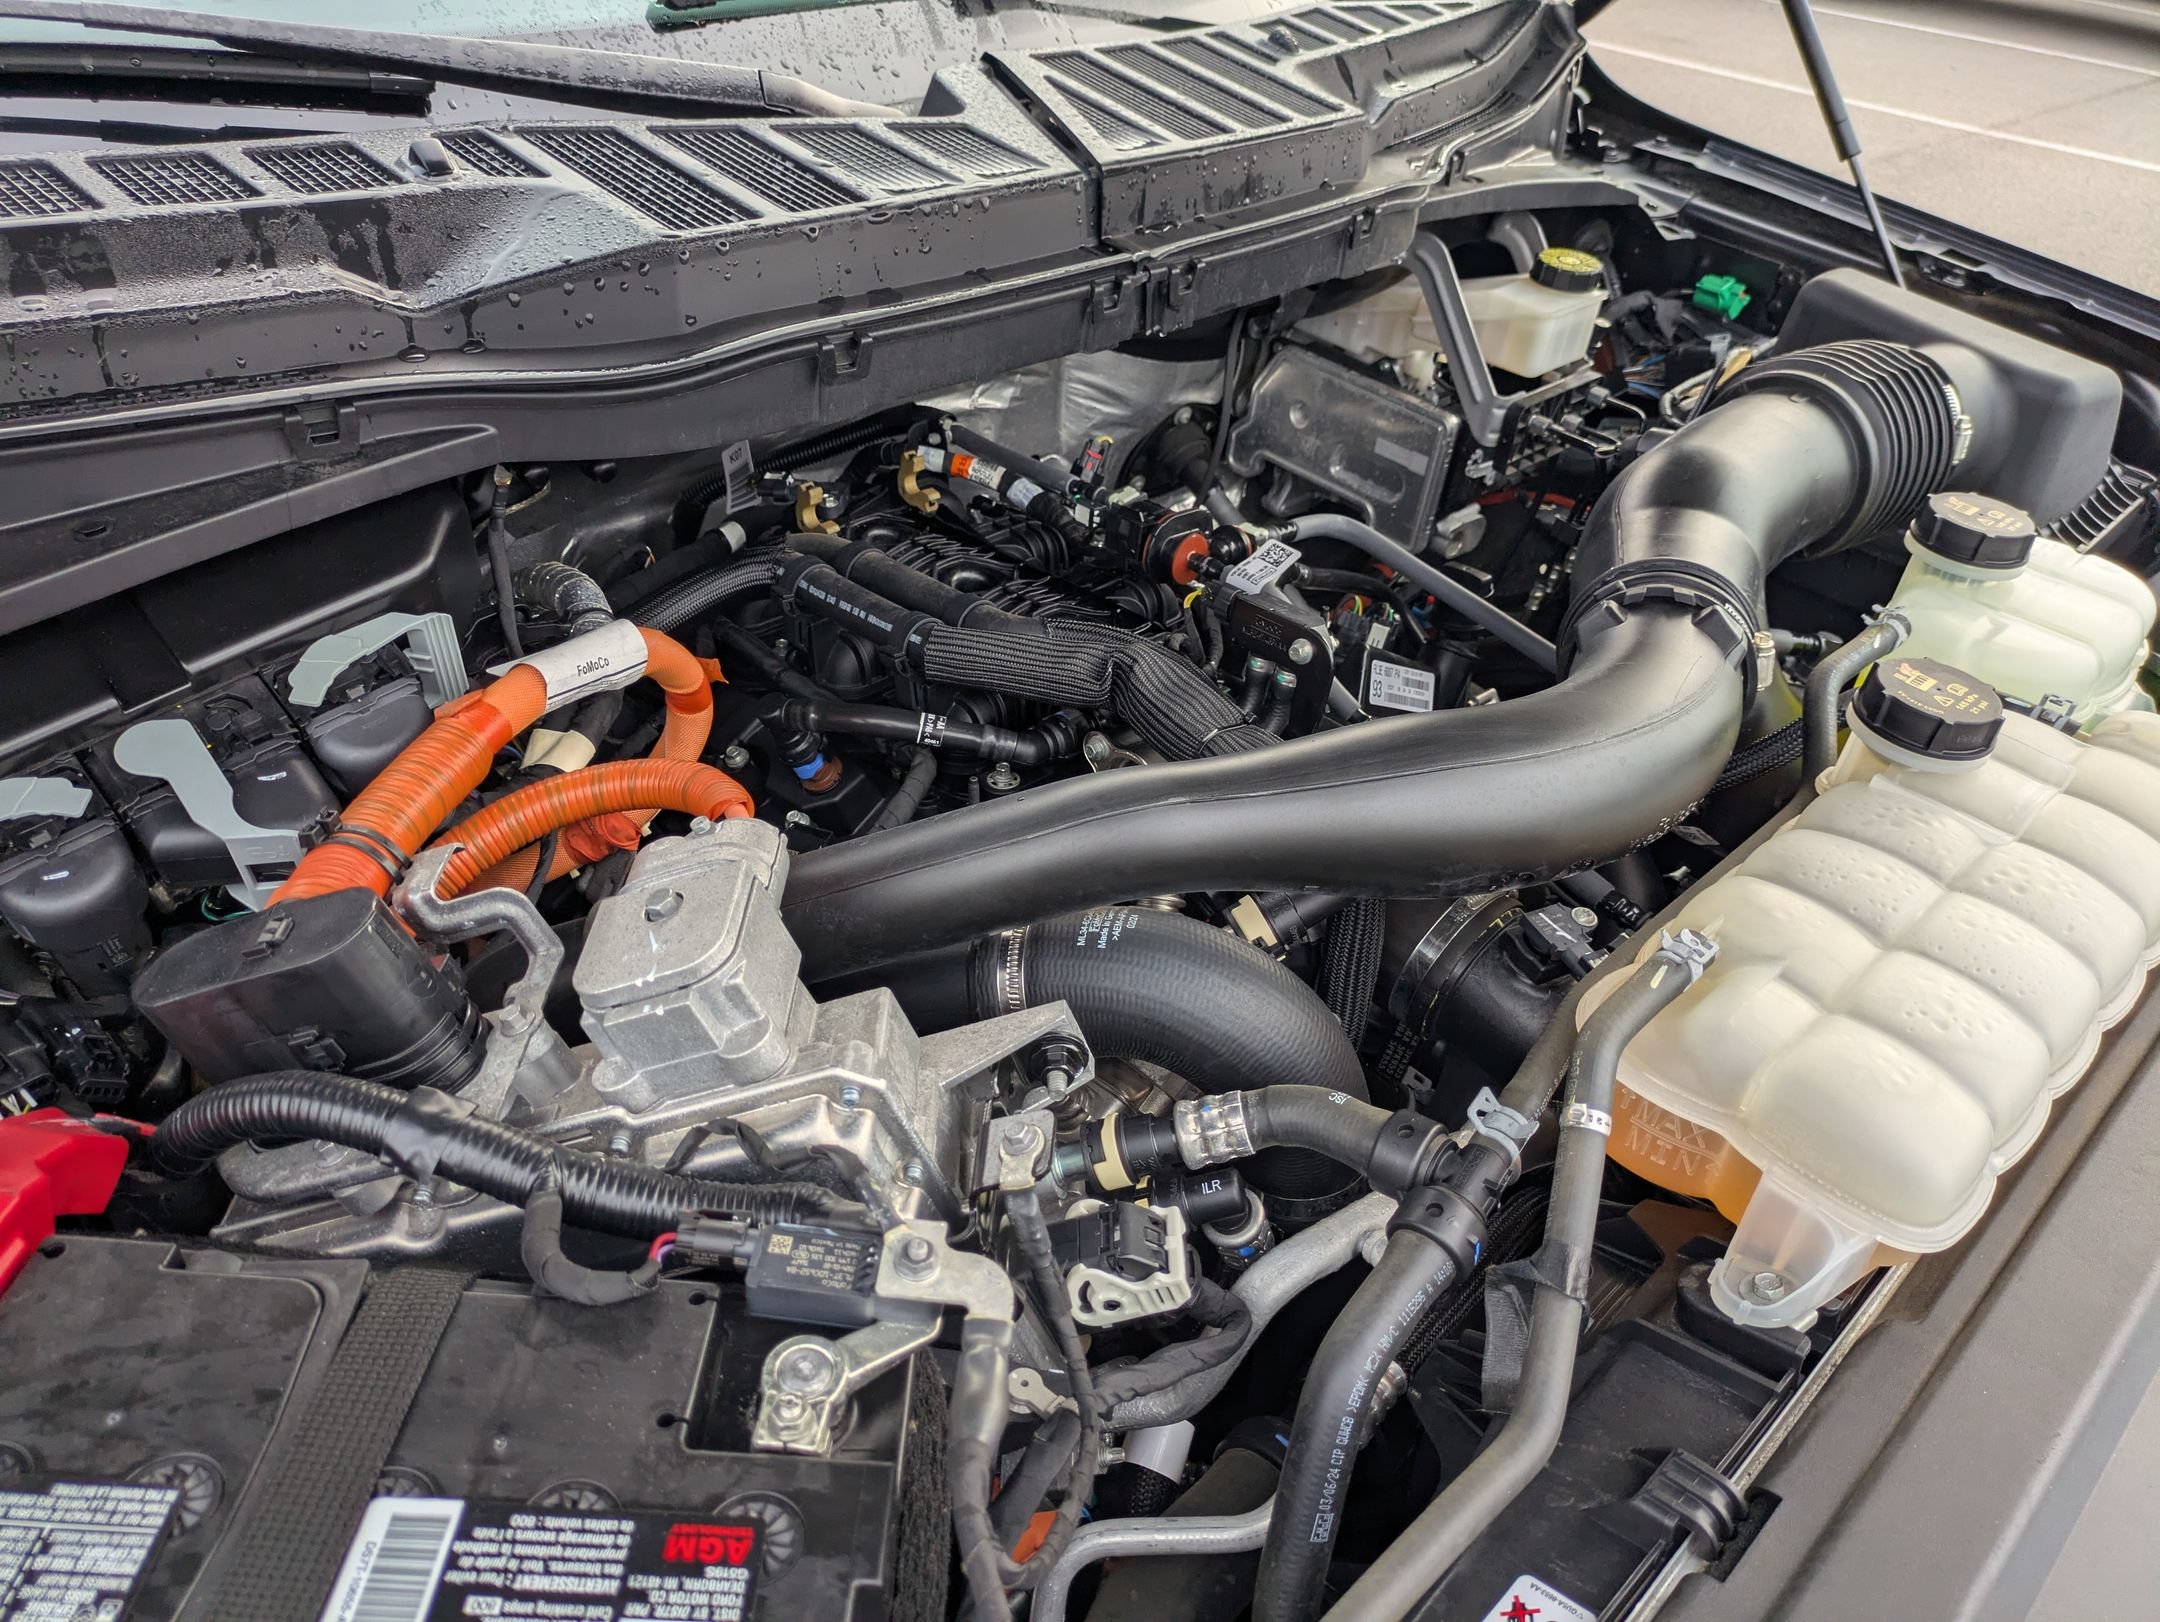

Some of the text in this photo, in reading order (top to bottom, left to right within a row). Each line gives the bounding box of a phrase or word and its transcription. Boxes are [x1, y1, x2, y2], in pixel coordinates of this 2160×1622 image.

[728, 449, 745, 464] K07
[576, 657, 610, 678] FoMoCo
[1373, 680, 1382, 697] 93
[1635, 1101, 1708, 1148] MAX
[1625, 1126, 1701, 1175] MIN
[1201, 1179, 1222, 1196] ILR
[1317, 1468, 1340, 1511] 03/06/24
[1331, 1449, 1345, 1466] CIP
[1346, 1374, 1369, 1414] >EPDM<
[662, 1535, 754, 1565] AGM
[669, 1590, 709, 1603] MOTOR
[712, 1592, 743, 1605] FORD
